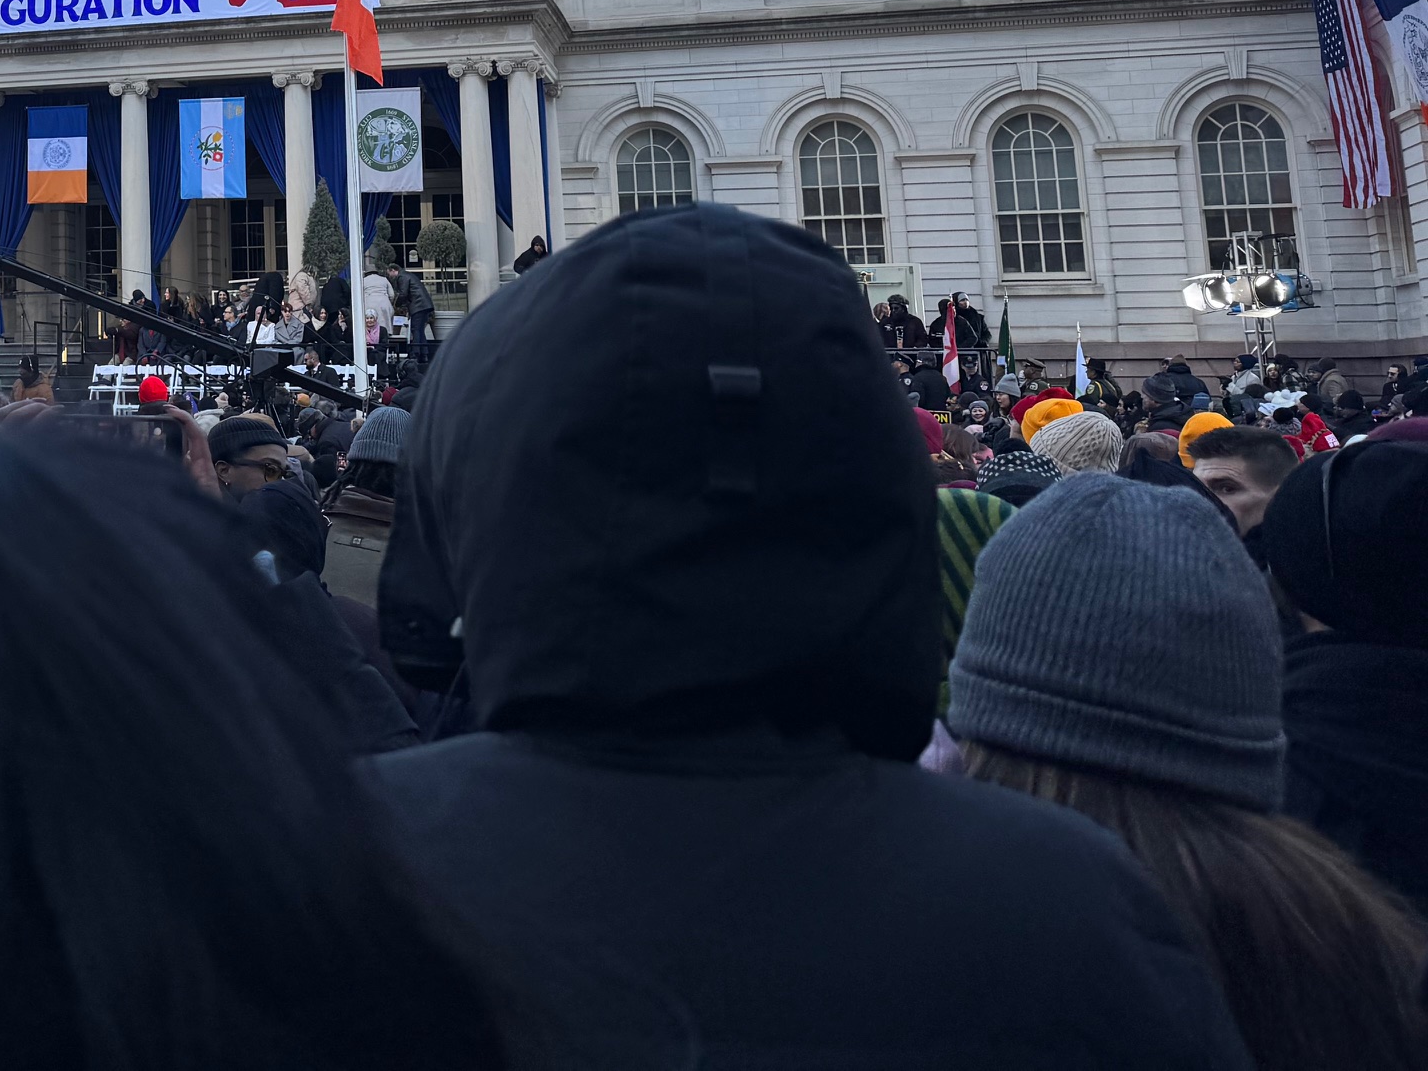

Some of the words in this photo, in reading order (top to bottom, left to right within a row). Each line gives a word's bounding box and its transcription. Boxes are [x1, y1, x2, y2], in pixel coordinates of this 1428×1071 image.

[401, 114, 418, 139] STATEN
[359, 149, 373, 166] YORK
[402, 140, 418, 165] ISLAND
